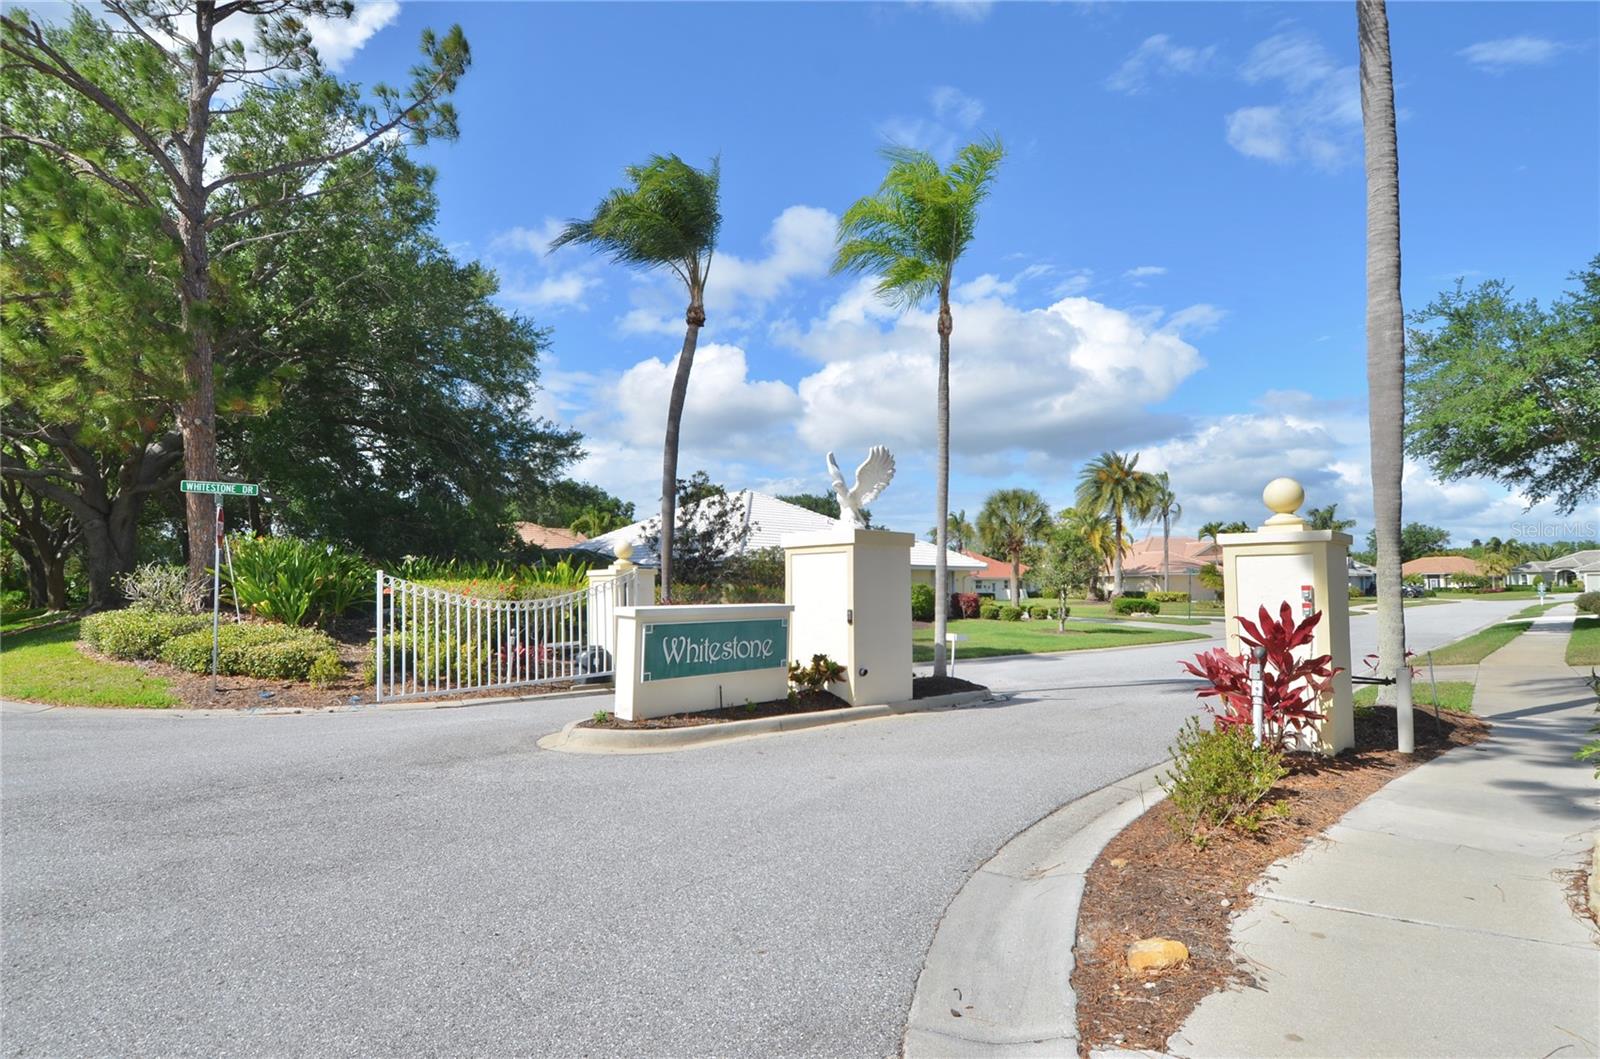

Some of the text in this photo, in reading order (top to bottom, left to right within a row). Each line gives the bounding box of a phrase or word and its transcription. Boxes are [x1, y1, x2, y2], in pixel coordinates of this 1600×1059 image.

[186, 482, 254, 494] WHITESTONE DR
[662, 636, 774, 665] Whitestone
